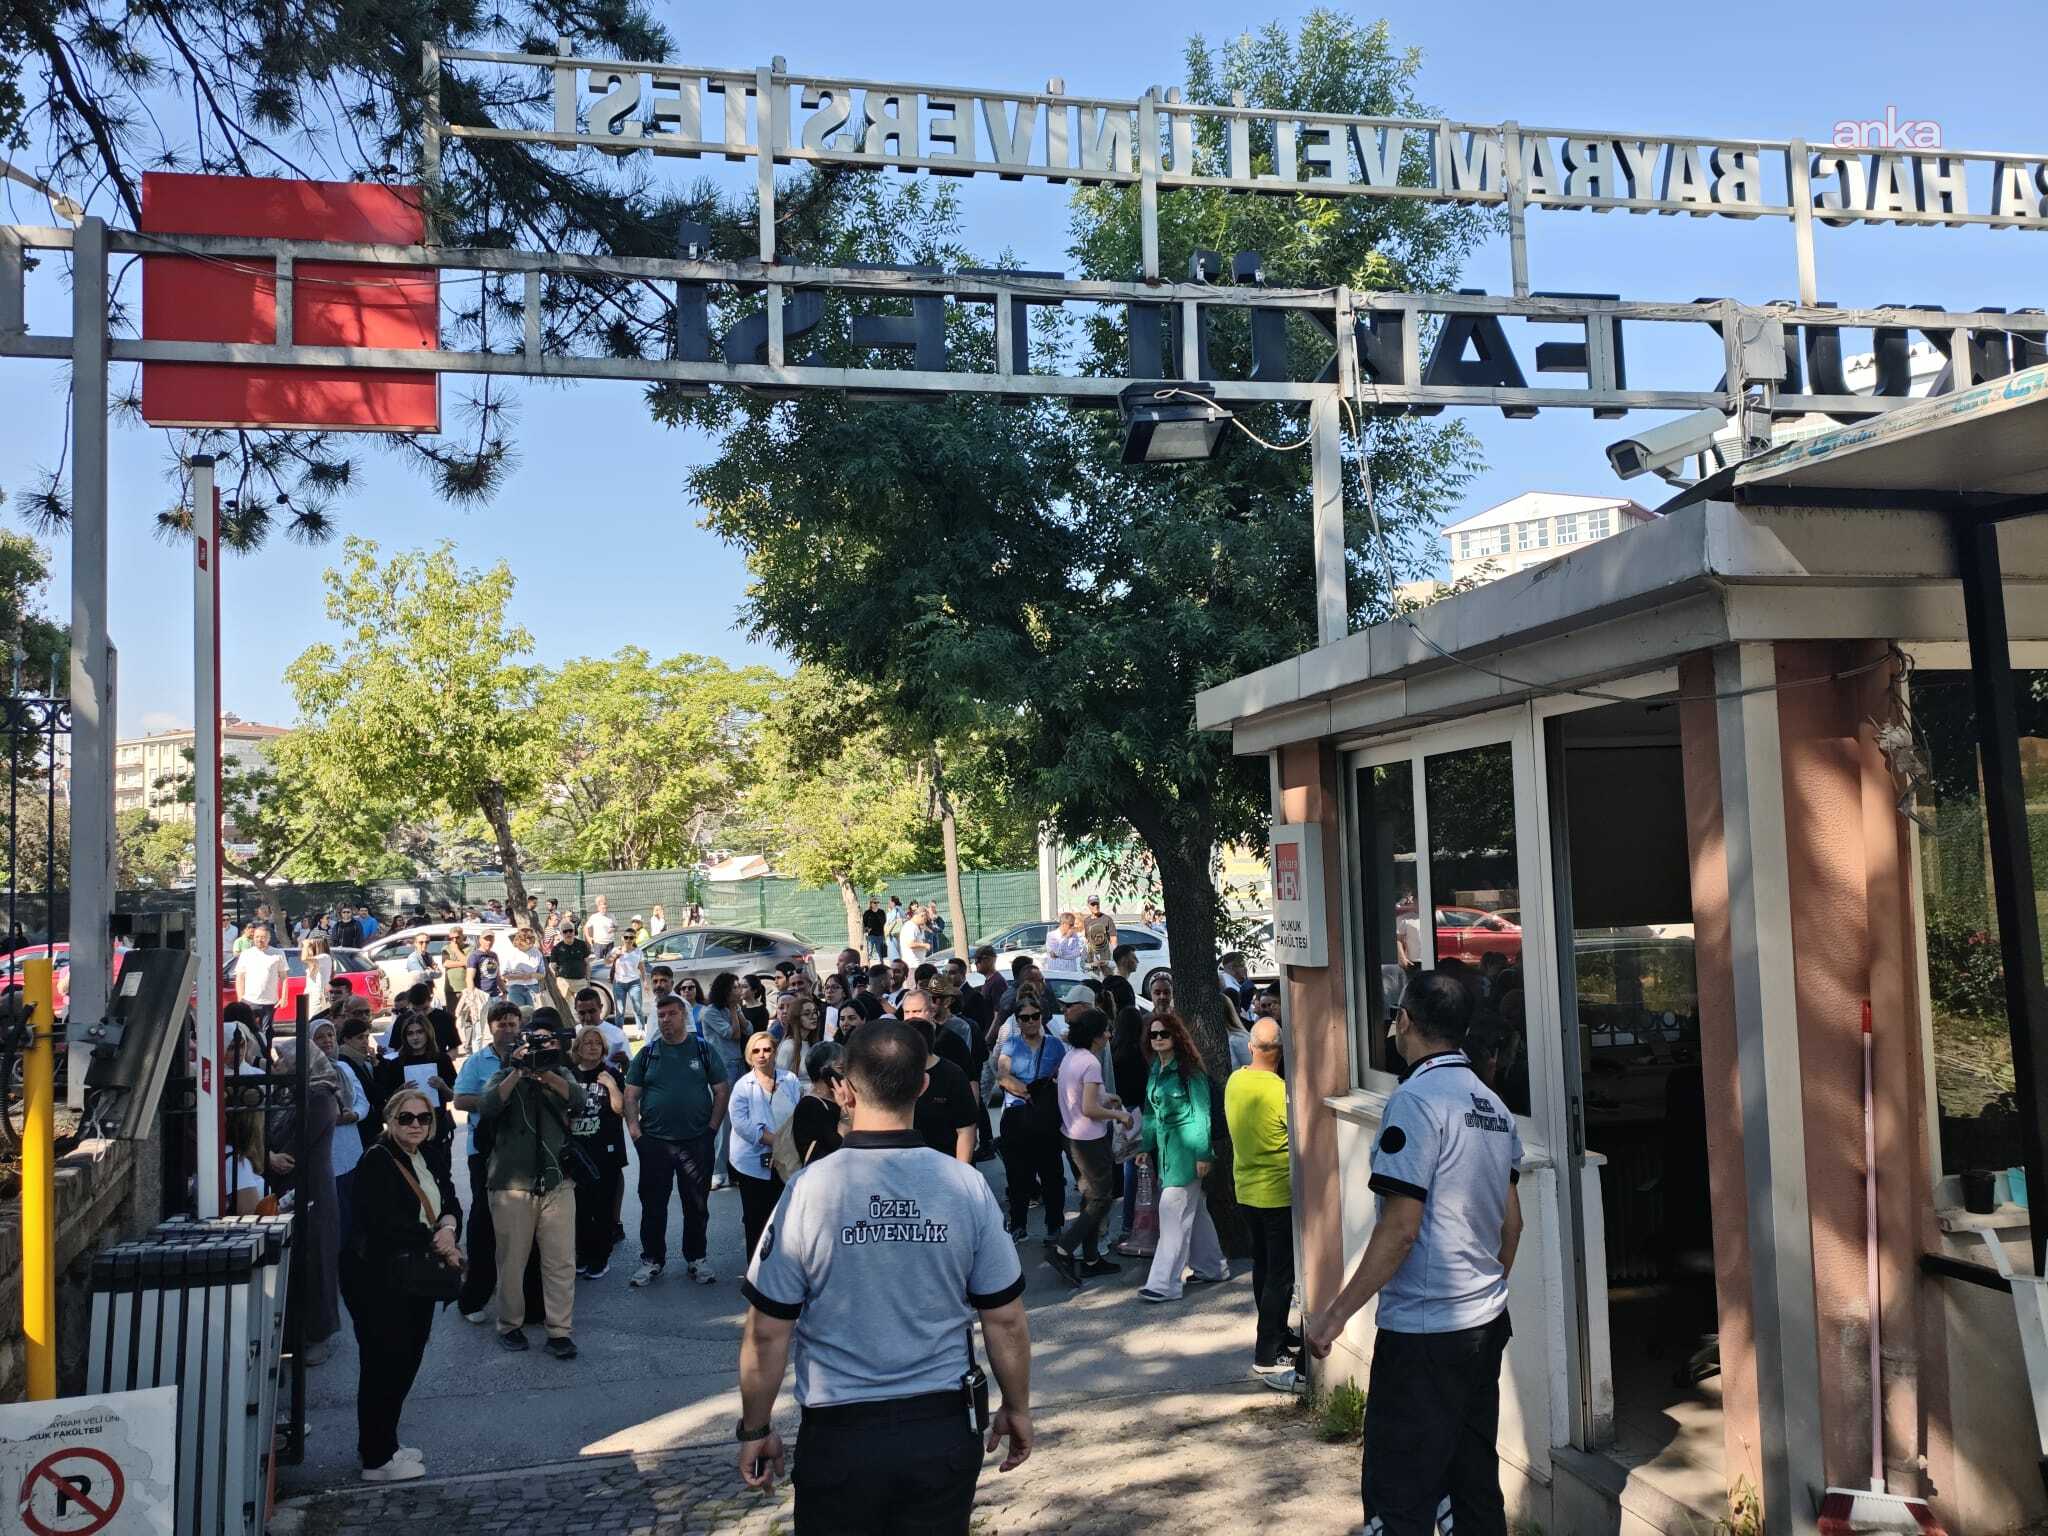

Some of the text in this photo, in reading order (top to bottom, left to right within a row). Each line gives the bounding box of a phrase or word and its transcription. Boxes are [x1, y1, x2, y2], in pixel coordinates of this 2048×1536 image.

[1280, 919, 1302, 932] HUKUK
[1276, 934, 1308, 949] FAKÜLTESİ
[869, 1195, 921, 1219] ÖZEL
[841, 1219, 948, 1246] GÜVENLİK
[53, 1425, 103, 1438] FAKÜLTESİ
